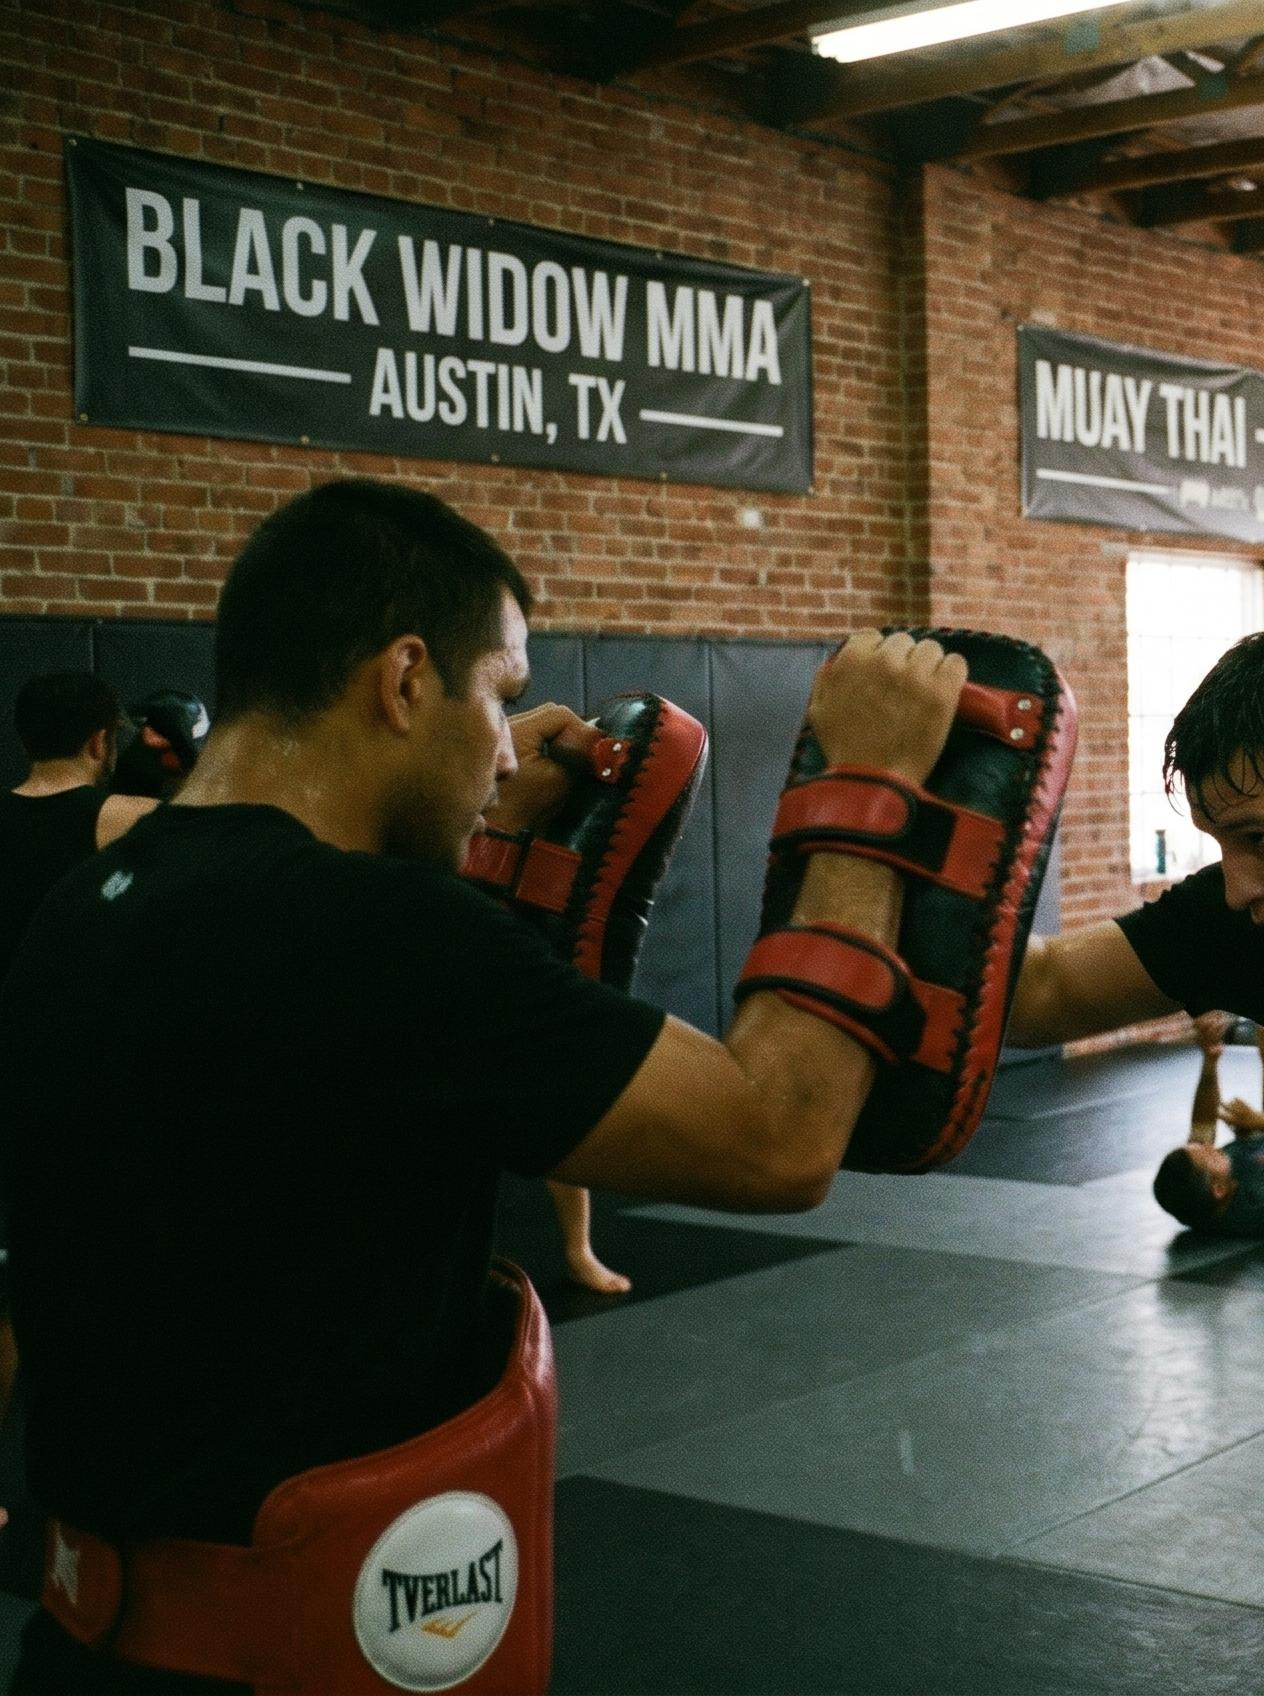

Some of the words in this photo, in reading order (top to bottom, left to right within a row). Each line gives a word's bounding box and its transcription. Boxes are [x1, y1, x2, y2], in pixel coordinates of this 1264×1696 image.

[126, 187, 380, 326] BLACK
[399, 235, 629, 362] WIDOW
[647, 281, 782, 386] MMA
[370, 348, 557, 445] AUSTIN,
[568, 373, 628, 445] TX
[1035, 360, 1153, 454] MUAY
[1159, 383, 1247, 469] THAI
